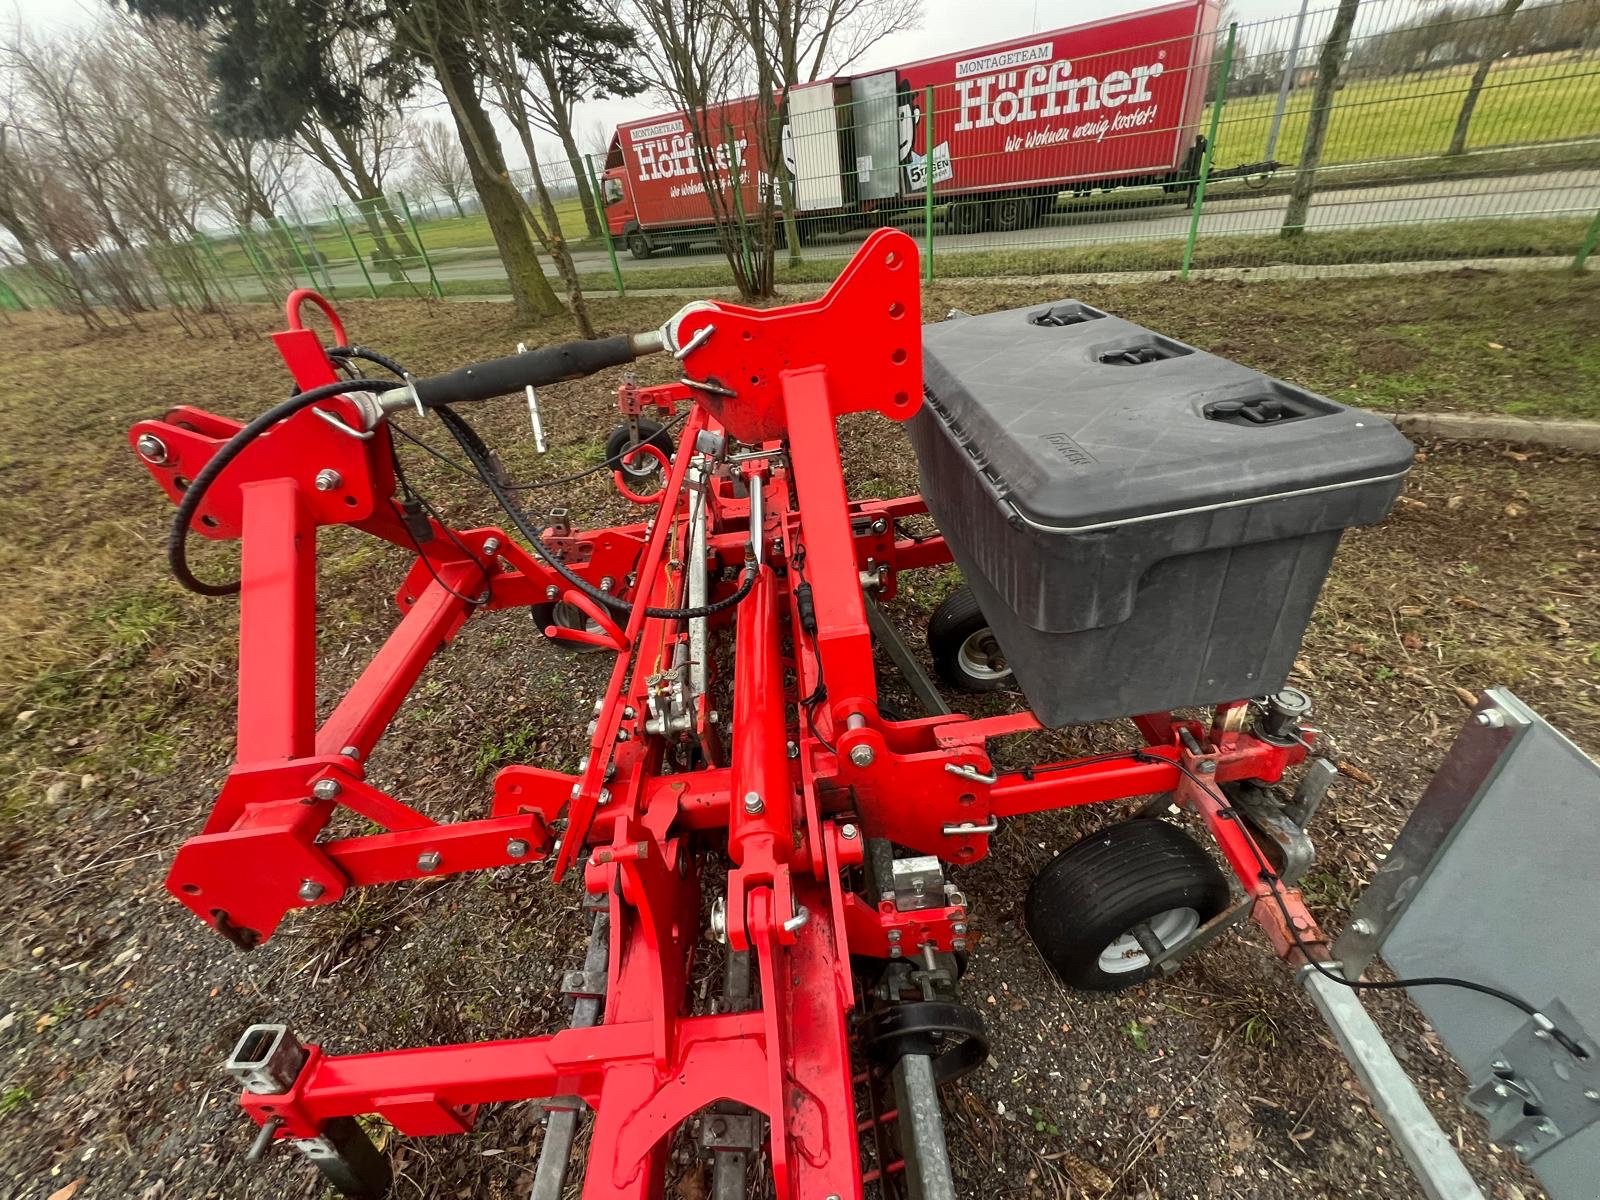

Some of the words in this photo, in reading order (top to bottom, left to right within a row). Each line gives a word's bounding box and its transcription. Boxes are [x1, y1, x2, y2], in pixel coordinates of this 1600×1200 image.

[959, 45, 1049, 75] MONTAGETEAM
[954, 60, 1164, 131] Höffner
[631, 122, 683, 139] MONTAGETEAM
[1004, 134, 1024, 153] Wo
[1025, 124, 1069, 149] Wohnen
[1072, 115, 1109, 143] wenig
[632, 132, 748, 181] Höffer
[910, 166, 922, 183] 5
[919, 160, 949, 177] TGEN
